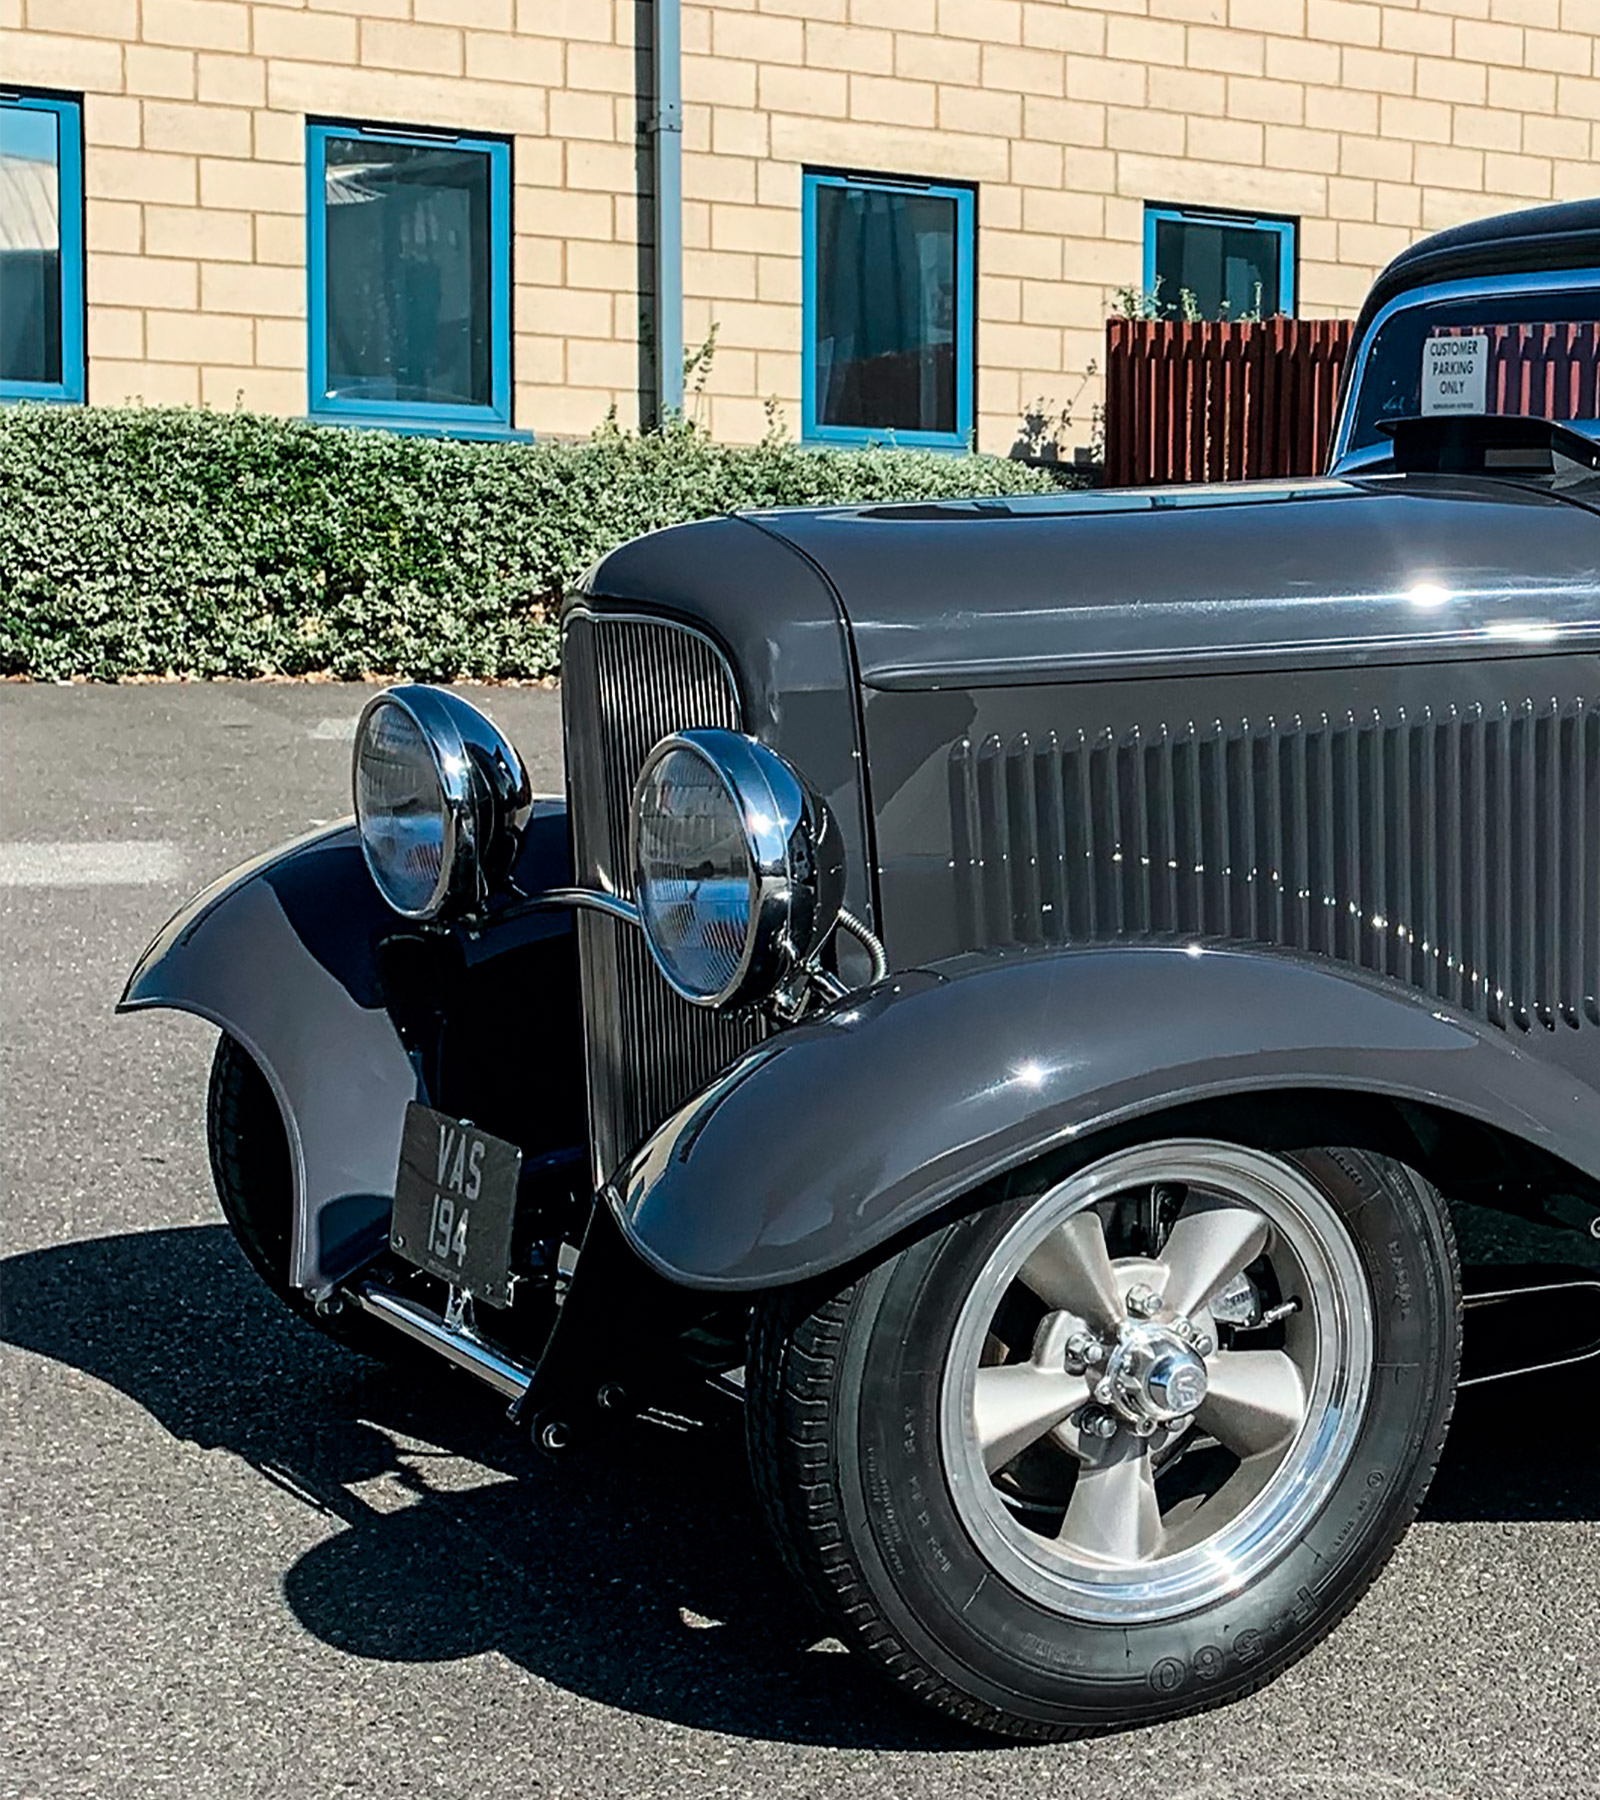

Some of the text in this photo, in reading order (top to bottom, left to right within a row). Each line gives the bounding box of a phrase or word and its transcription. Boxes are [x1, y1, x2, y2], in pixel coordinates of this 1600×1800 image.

[1430, 340, 1478, 356] CUSTOMER
[1432, 360, 1474, 376] PARKING
[1439, 380, 1465, 395] ONLY
[436, 1123, 486, 1201] VAS
[427, 1192, 470, 1269] 194
